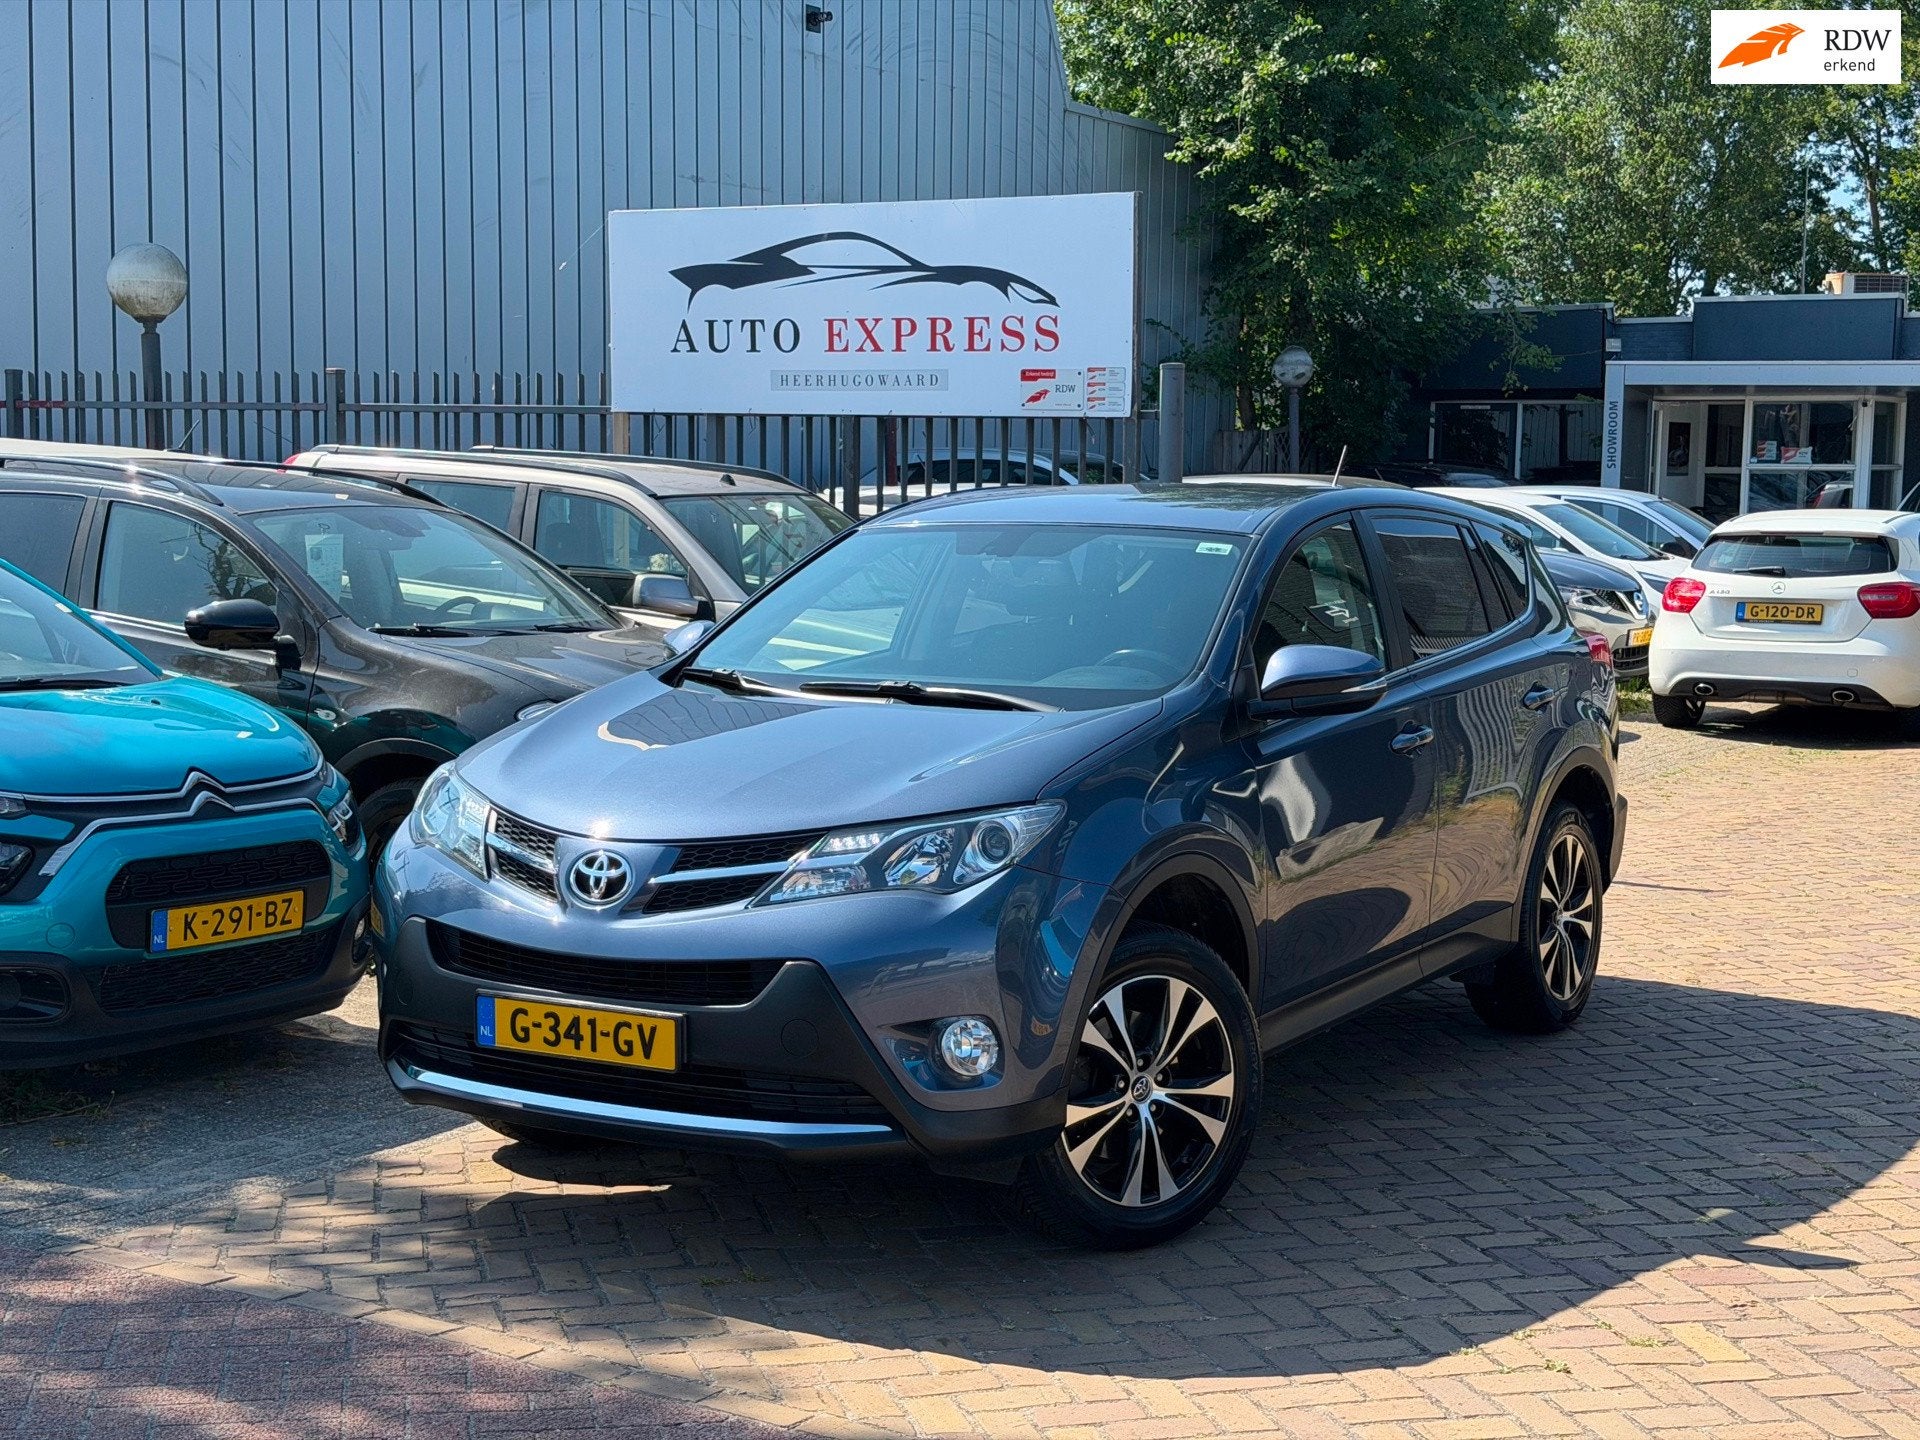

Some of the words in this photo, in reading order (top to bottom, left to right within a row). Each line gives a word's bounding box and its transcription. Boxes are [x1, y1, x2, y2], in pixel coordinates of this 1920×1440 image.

[670, 318, 801, 353] AUTO
[823, 314, 1061, 353] EXPRESS
[780, 373, 940, 387] HEERHUGOWAARD
[1055, 384, 1076, 393] RDW
[1606, 400, 1619, 469] SHOWROOM
[1750, 605, 1816, 619] G-120-DR
[183, 897, 294, 942] K-291-BZ
[153, 934, 165, 944] NL
[480, 1025, 493, 1037] NL
[510, 1007, 658, 1060] G-341-GV
